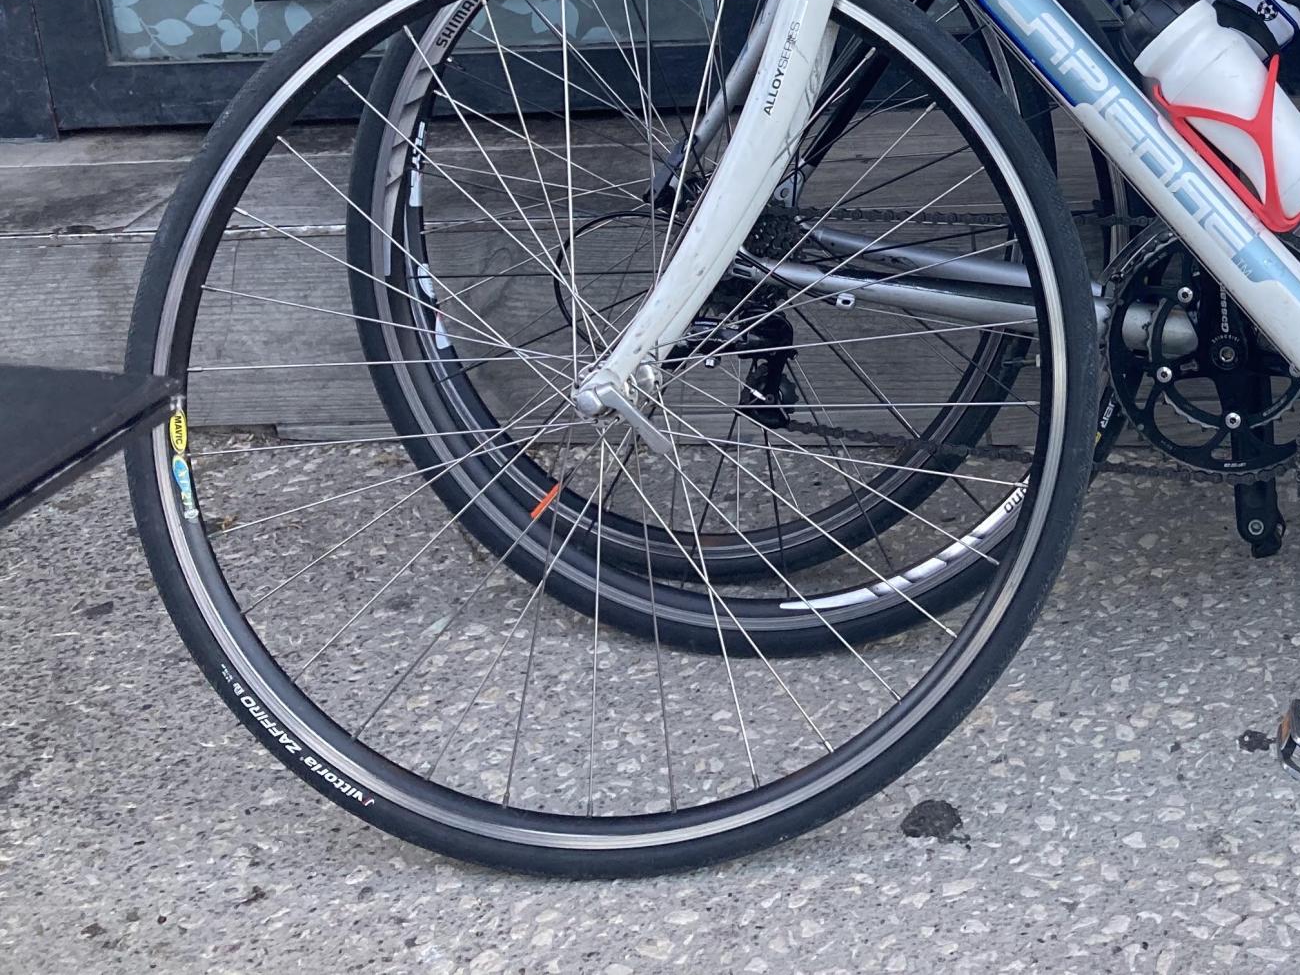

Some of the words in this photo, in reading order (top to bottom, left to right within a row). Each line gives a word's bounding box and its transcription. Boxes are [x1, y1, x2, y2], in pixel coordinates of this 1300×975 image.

[763, 69, 784, 116] ALLOY
[174, 415, 184, 446] MAVIC
[240, 695, 302, 754] ZAFFIRO
